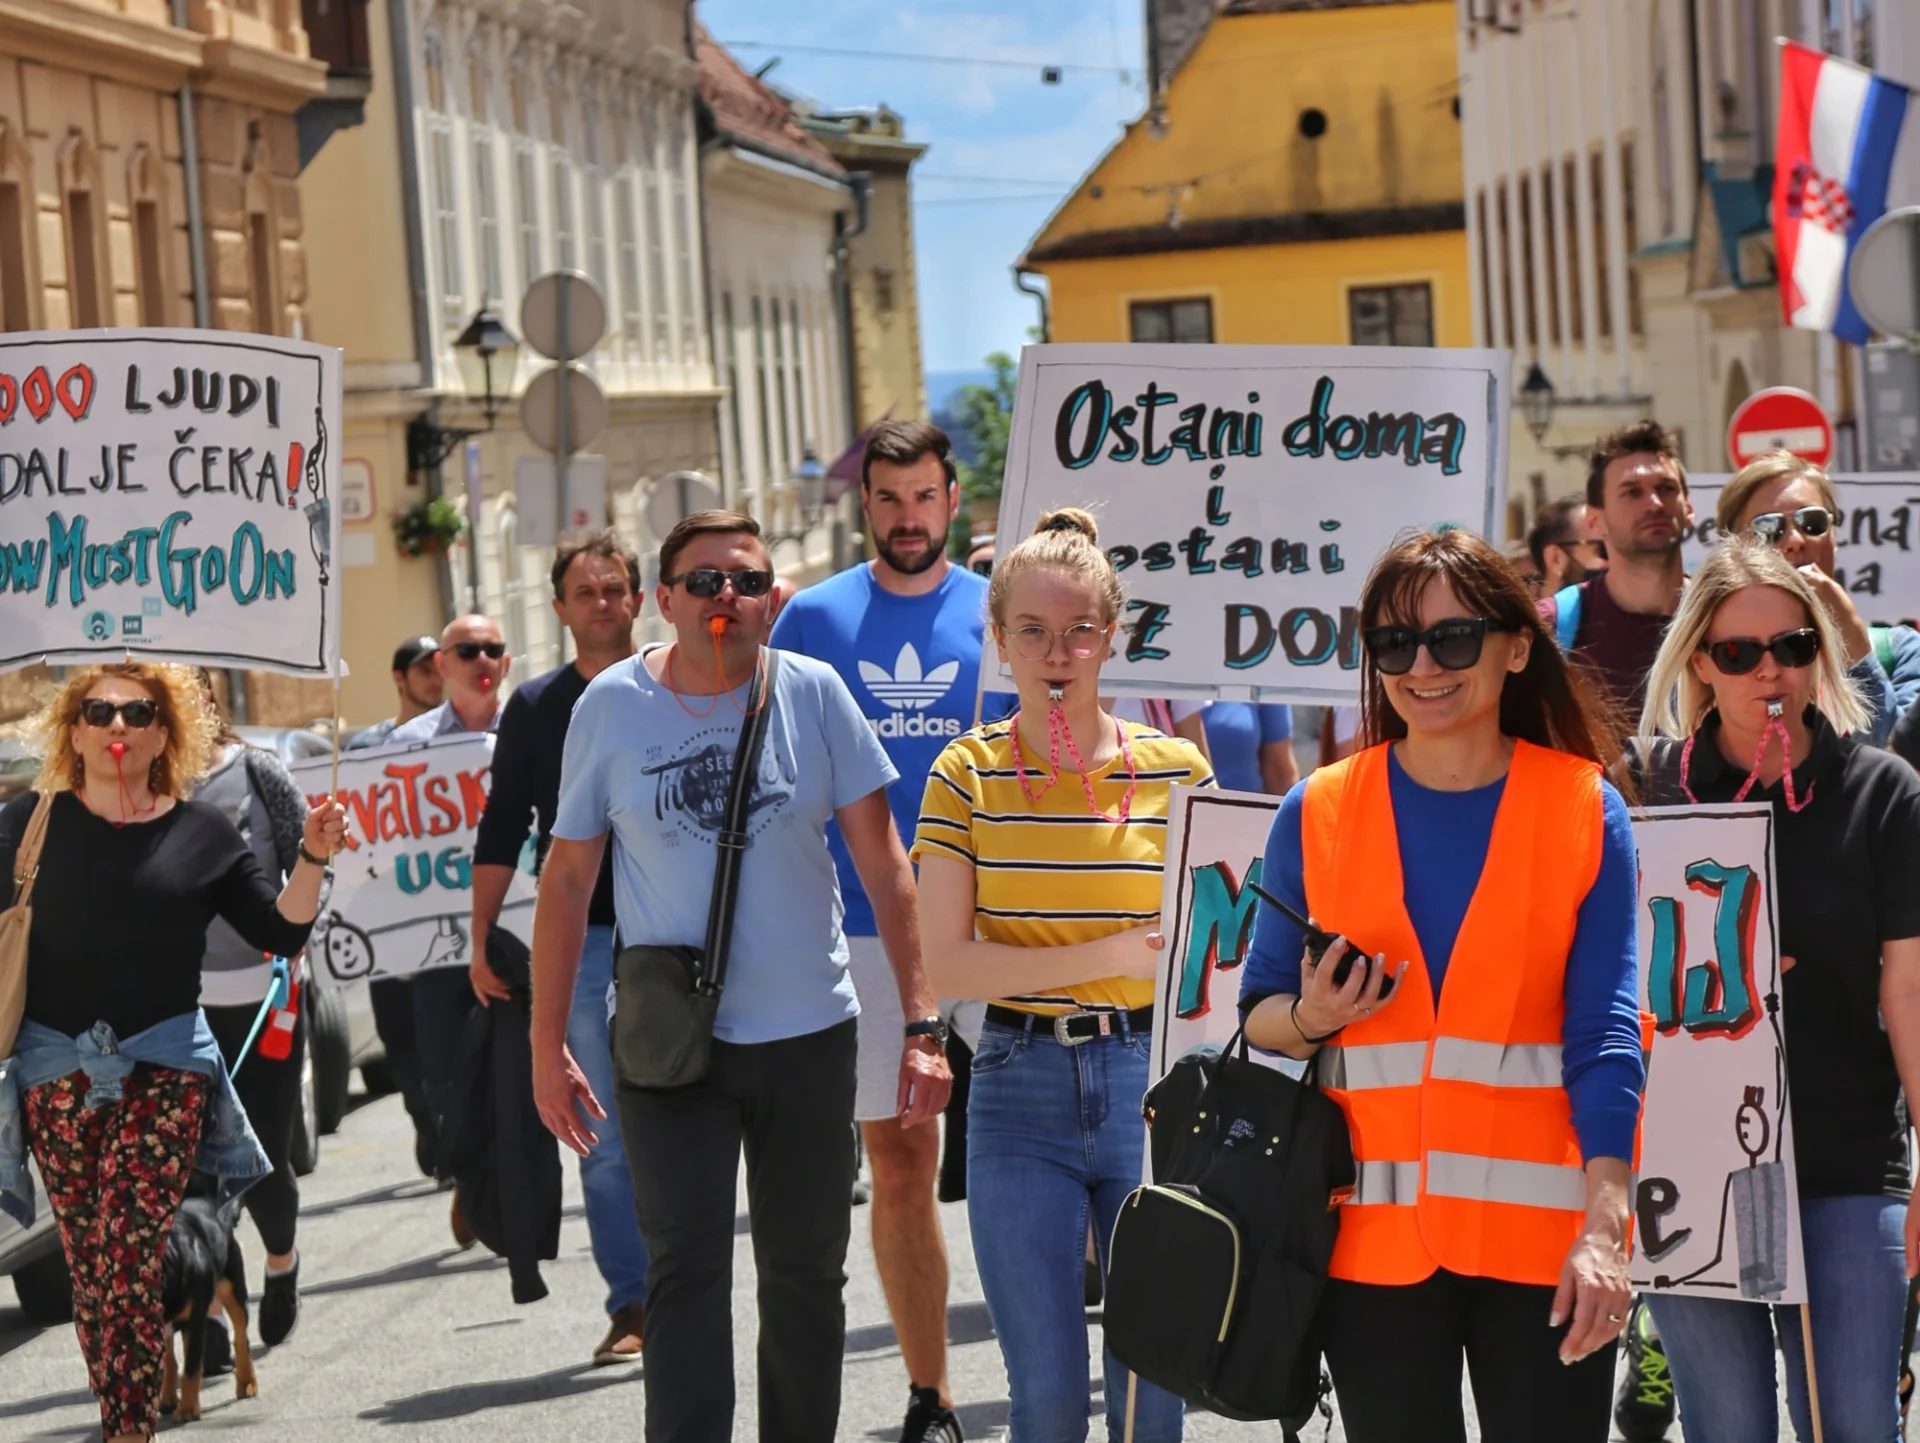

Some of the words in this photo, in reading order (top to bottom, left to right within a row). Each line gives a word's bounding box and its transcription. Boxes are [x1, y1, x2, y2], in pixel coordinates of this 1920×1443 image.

[125, 364, 281, 429] LJUDI
[1055, 380, 1263, 471] Ostani
[1281, 375, 1466, 476] doma
[168, 427, 304, 510] ČEKA!
[1206, 464, 1231, 526] i
